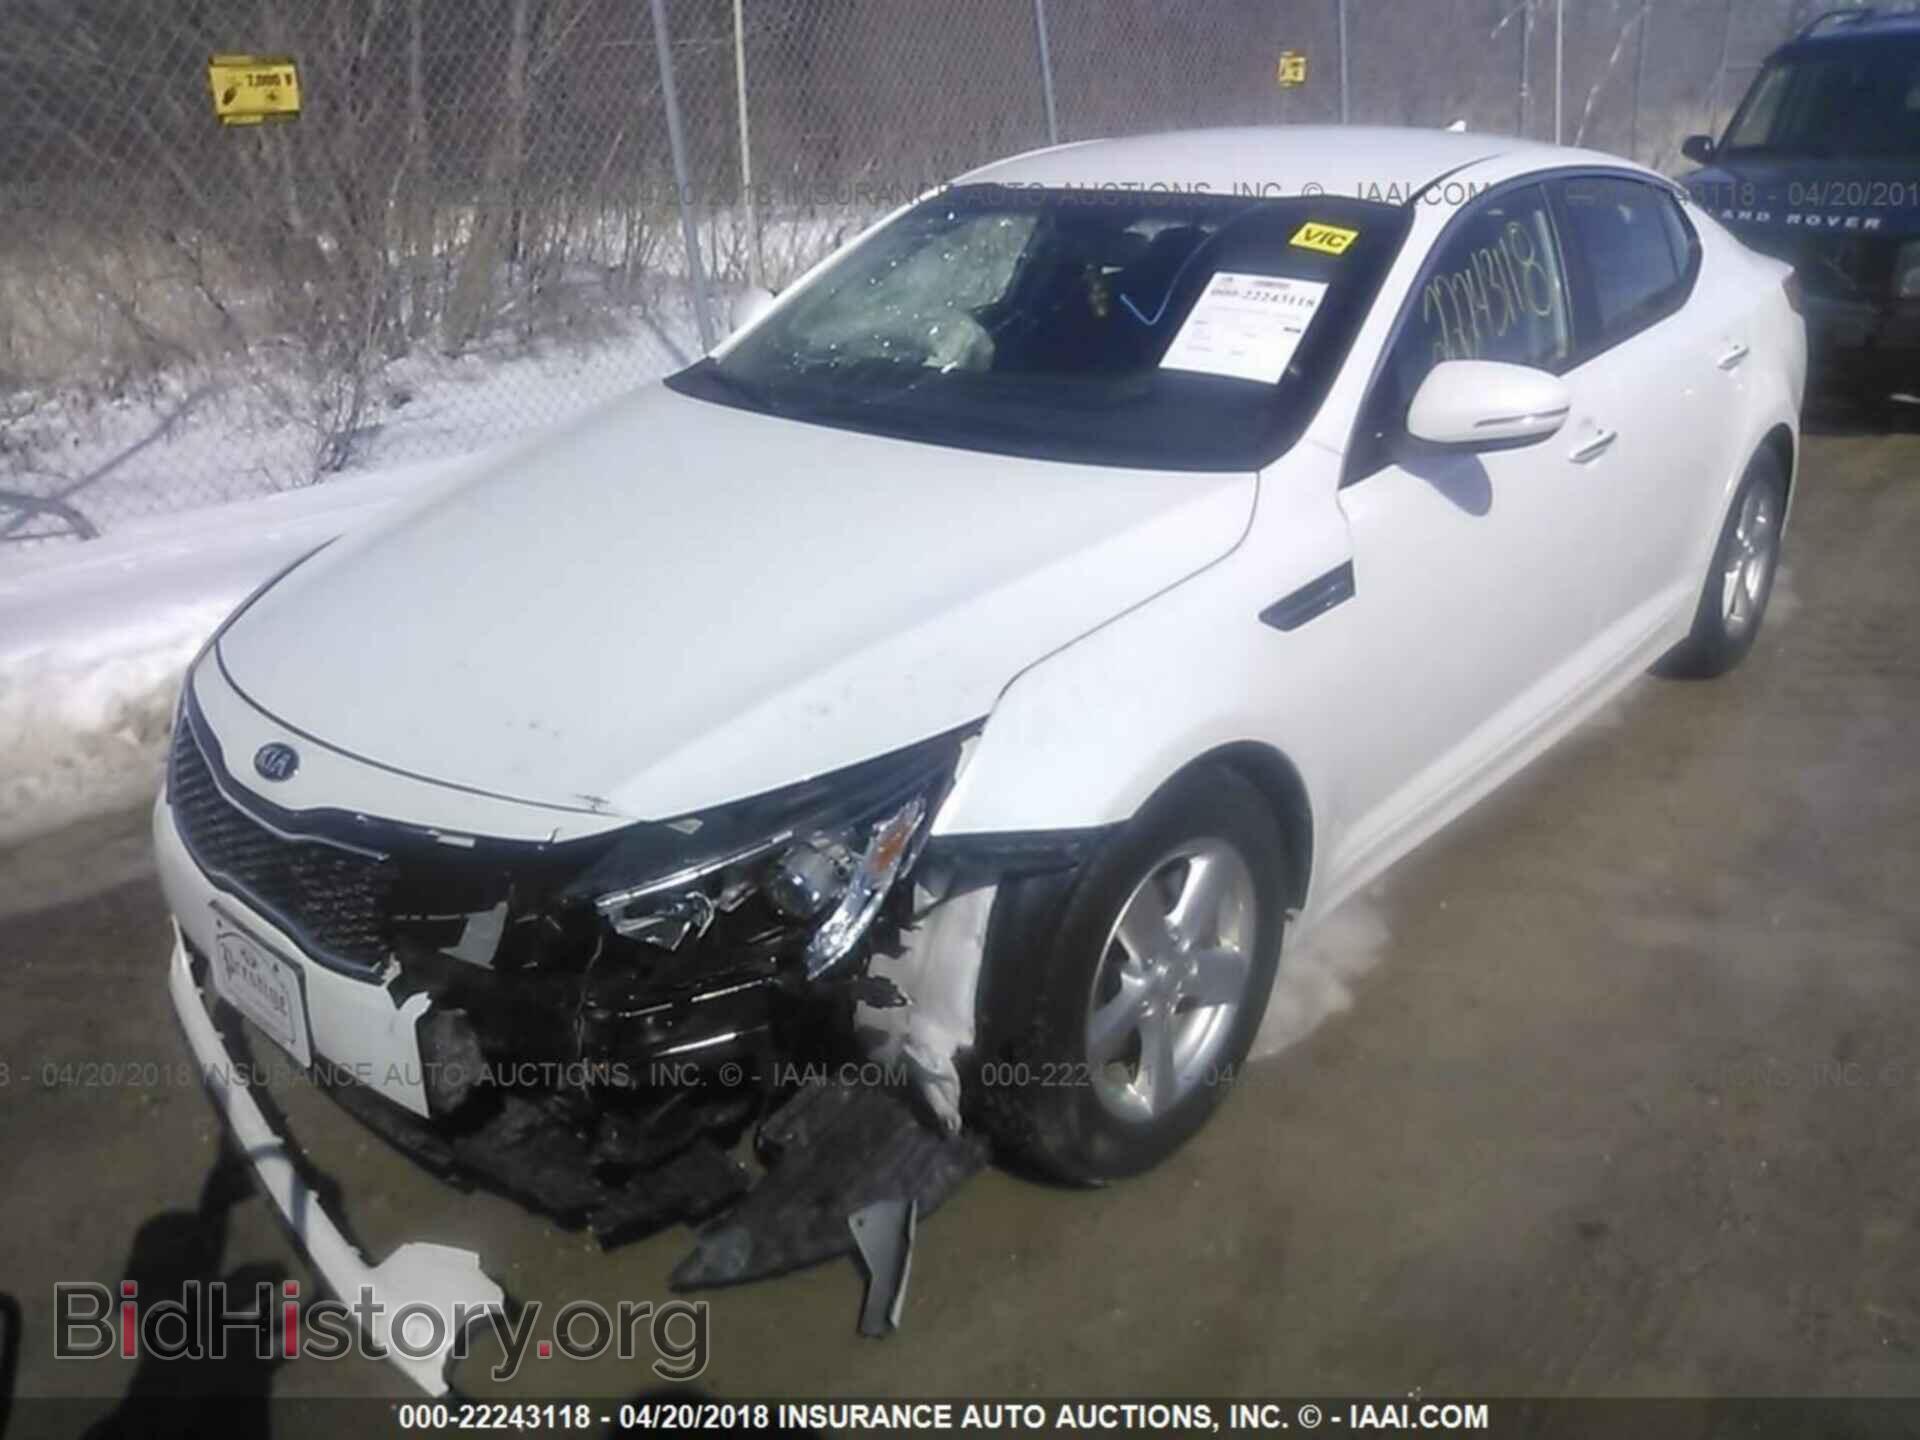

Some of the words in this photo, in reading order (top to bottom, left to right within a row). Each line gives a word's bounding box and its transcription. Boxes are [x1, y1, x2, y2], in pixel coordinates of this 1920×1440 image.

[1708, 209, 1771, 223] AND
[1786, 213, 1882, 231] ROVER
[1301, 226, 1348, 249] VIC
